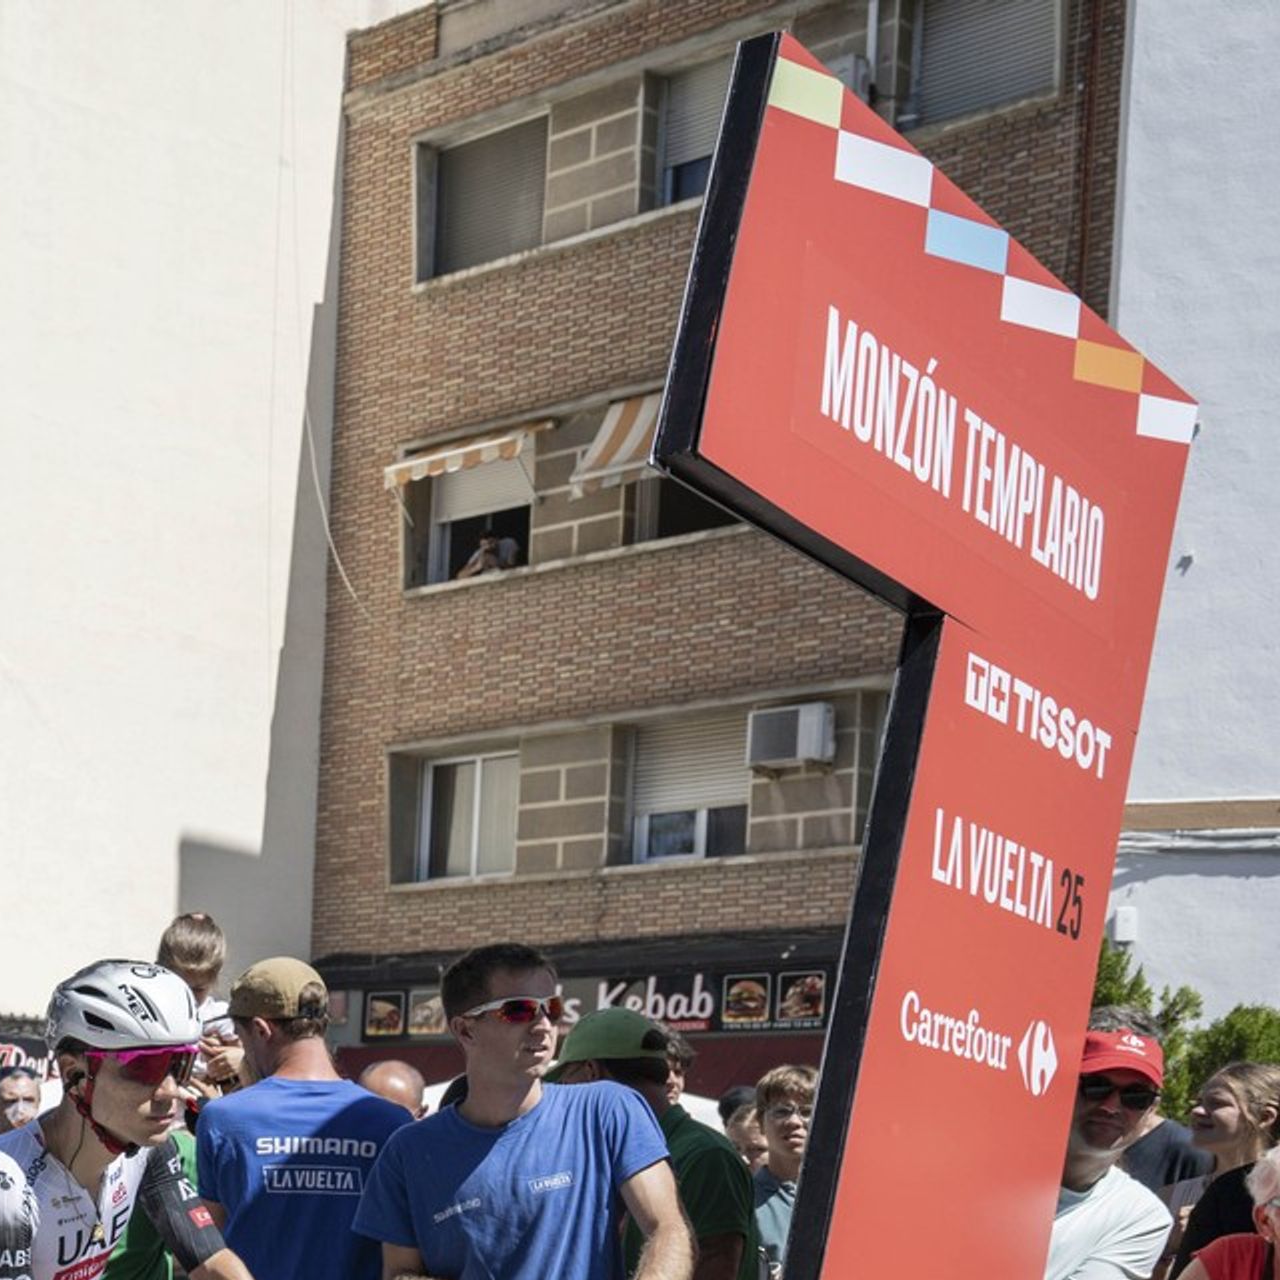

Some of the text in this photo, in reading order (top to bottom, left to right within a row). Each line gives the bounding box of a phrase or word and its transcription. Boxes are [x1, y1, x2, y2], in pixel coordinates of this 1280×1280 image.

[820, 304, 1104, 600] MONZÓN TEMPLARIO
[1013, 677, 1111, 778] TISSOT
[932, 808, 1085, 940] LA VUELTA 25
[118, 984, 153, 1023] MET
[598, 974, 714, 1021] Kebab
[901, 990, 1011, 1071] Carrefour
[256, 1136, 377, 1158] SHIMANO
[272, 1167, 354, 1190] LA VUELTA
[57, 1205, 129, 1267] UAE
